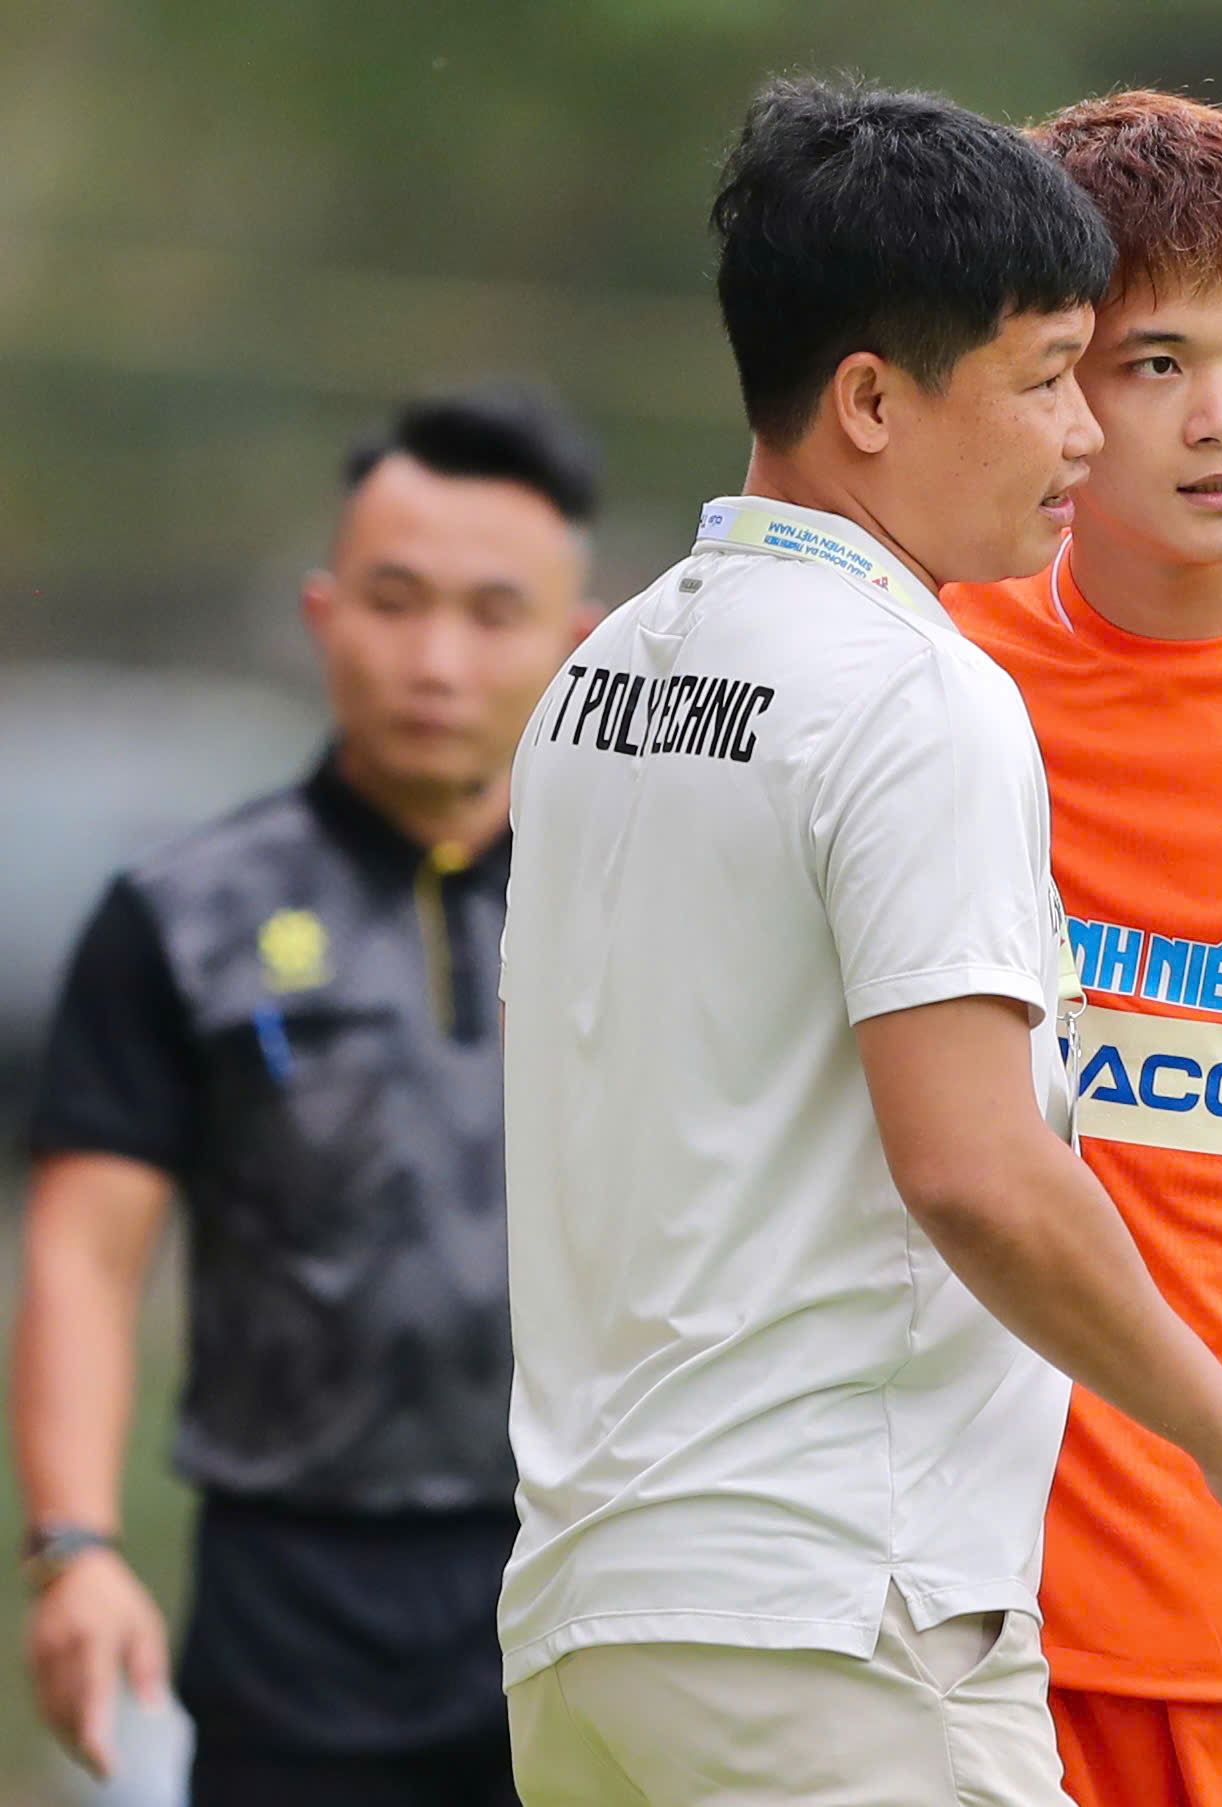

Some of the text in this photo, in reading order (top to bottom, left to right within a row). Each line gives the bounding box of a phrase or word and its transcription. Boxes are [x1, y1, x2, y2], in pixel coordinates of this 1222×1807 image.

[768, 521, 796, 537] NAM
[795, 528, 819, 544] VIỆT
[846, 549, 873, 572] SINH
[572, 668, 775, 763] POLYECHNIC
